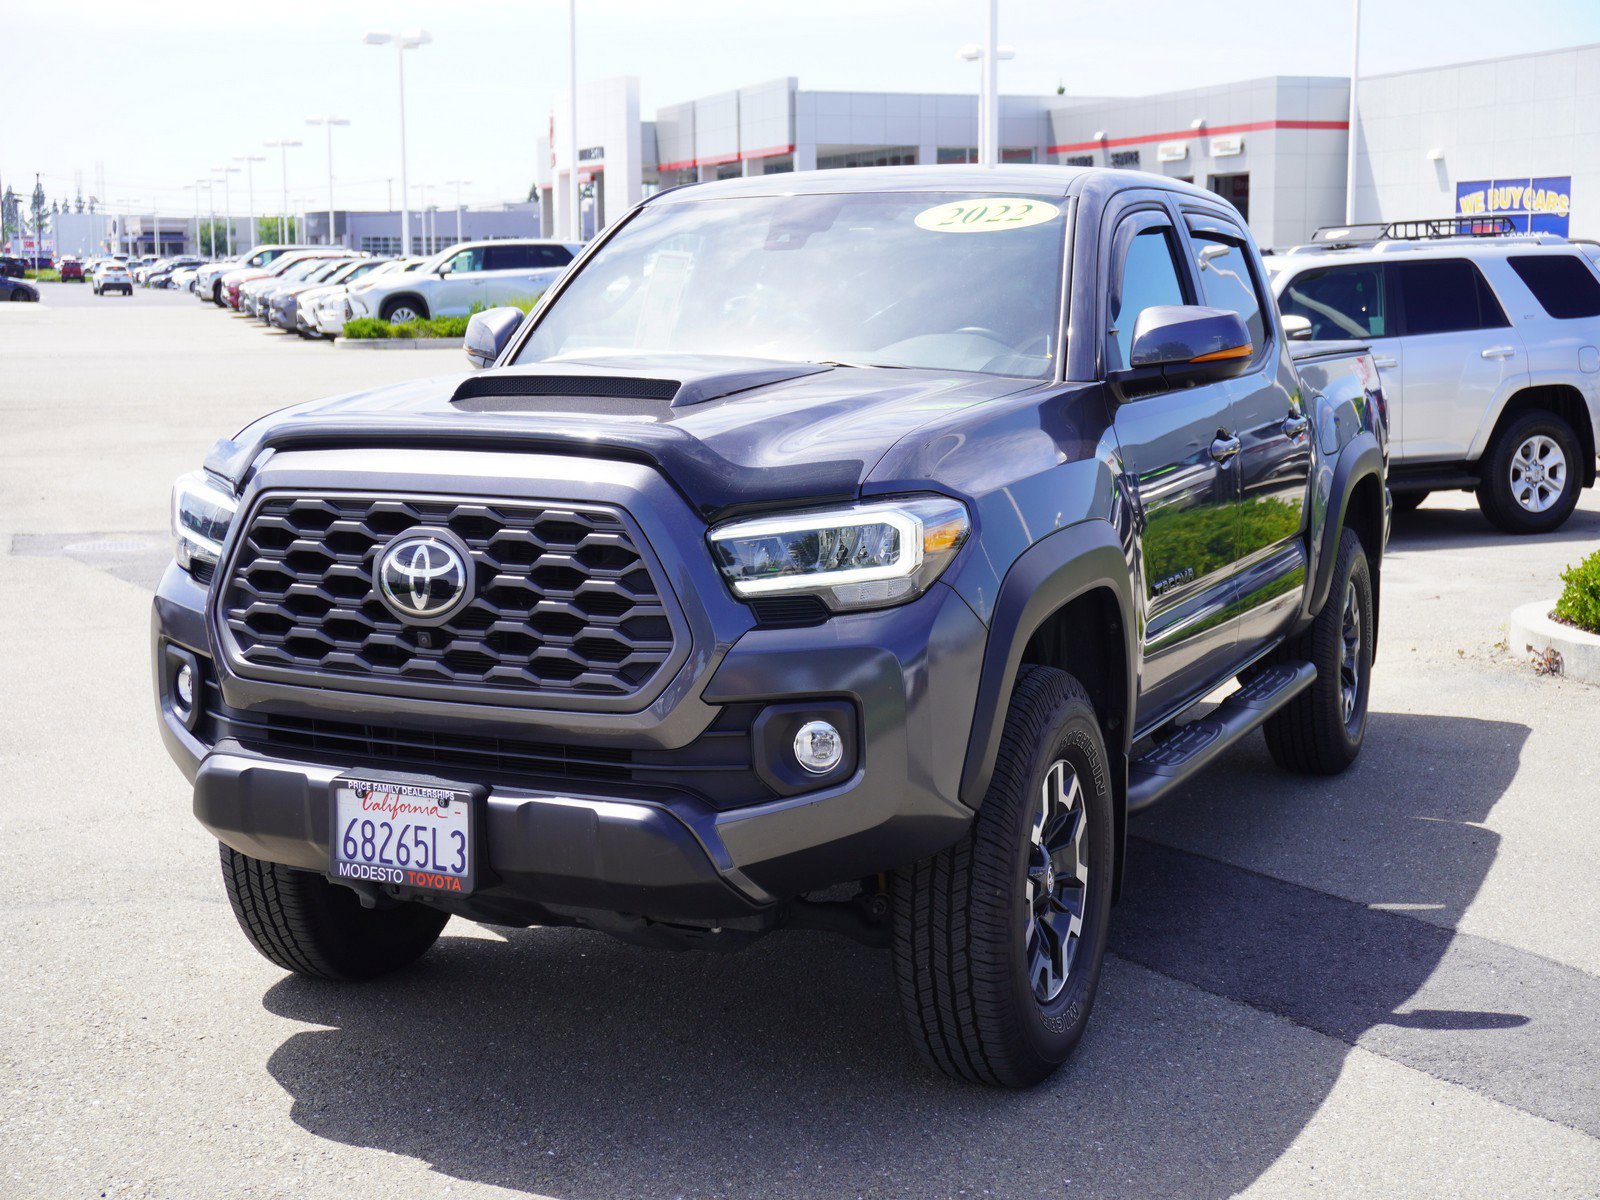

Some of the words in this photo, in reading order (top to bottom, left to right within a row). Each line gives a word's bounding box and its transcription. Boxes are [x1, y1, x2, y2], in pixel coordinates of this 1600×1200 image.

[937, 204, 1033, 226] 2022
[1459, 190, 1485, 215] WE
[1487, 186, 1525, 211] BUY
[1522, 188, 1570, 217] CARS
[348, 780, 371, 791] PRICE
[373, 783, 400, 794] FAMILY
[402, 786, 455, 800] DEALERSHIPS
[362, 790, 448, 820] California
[343, 818, 466, 873] 68265L3
[339, 862, 404, 884] MODESTO
[406, 871, 462, 892] TOYOTA
